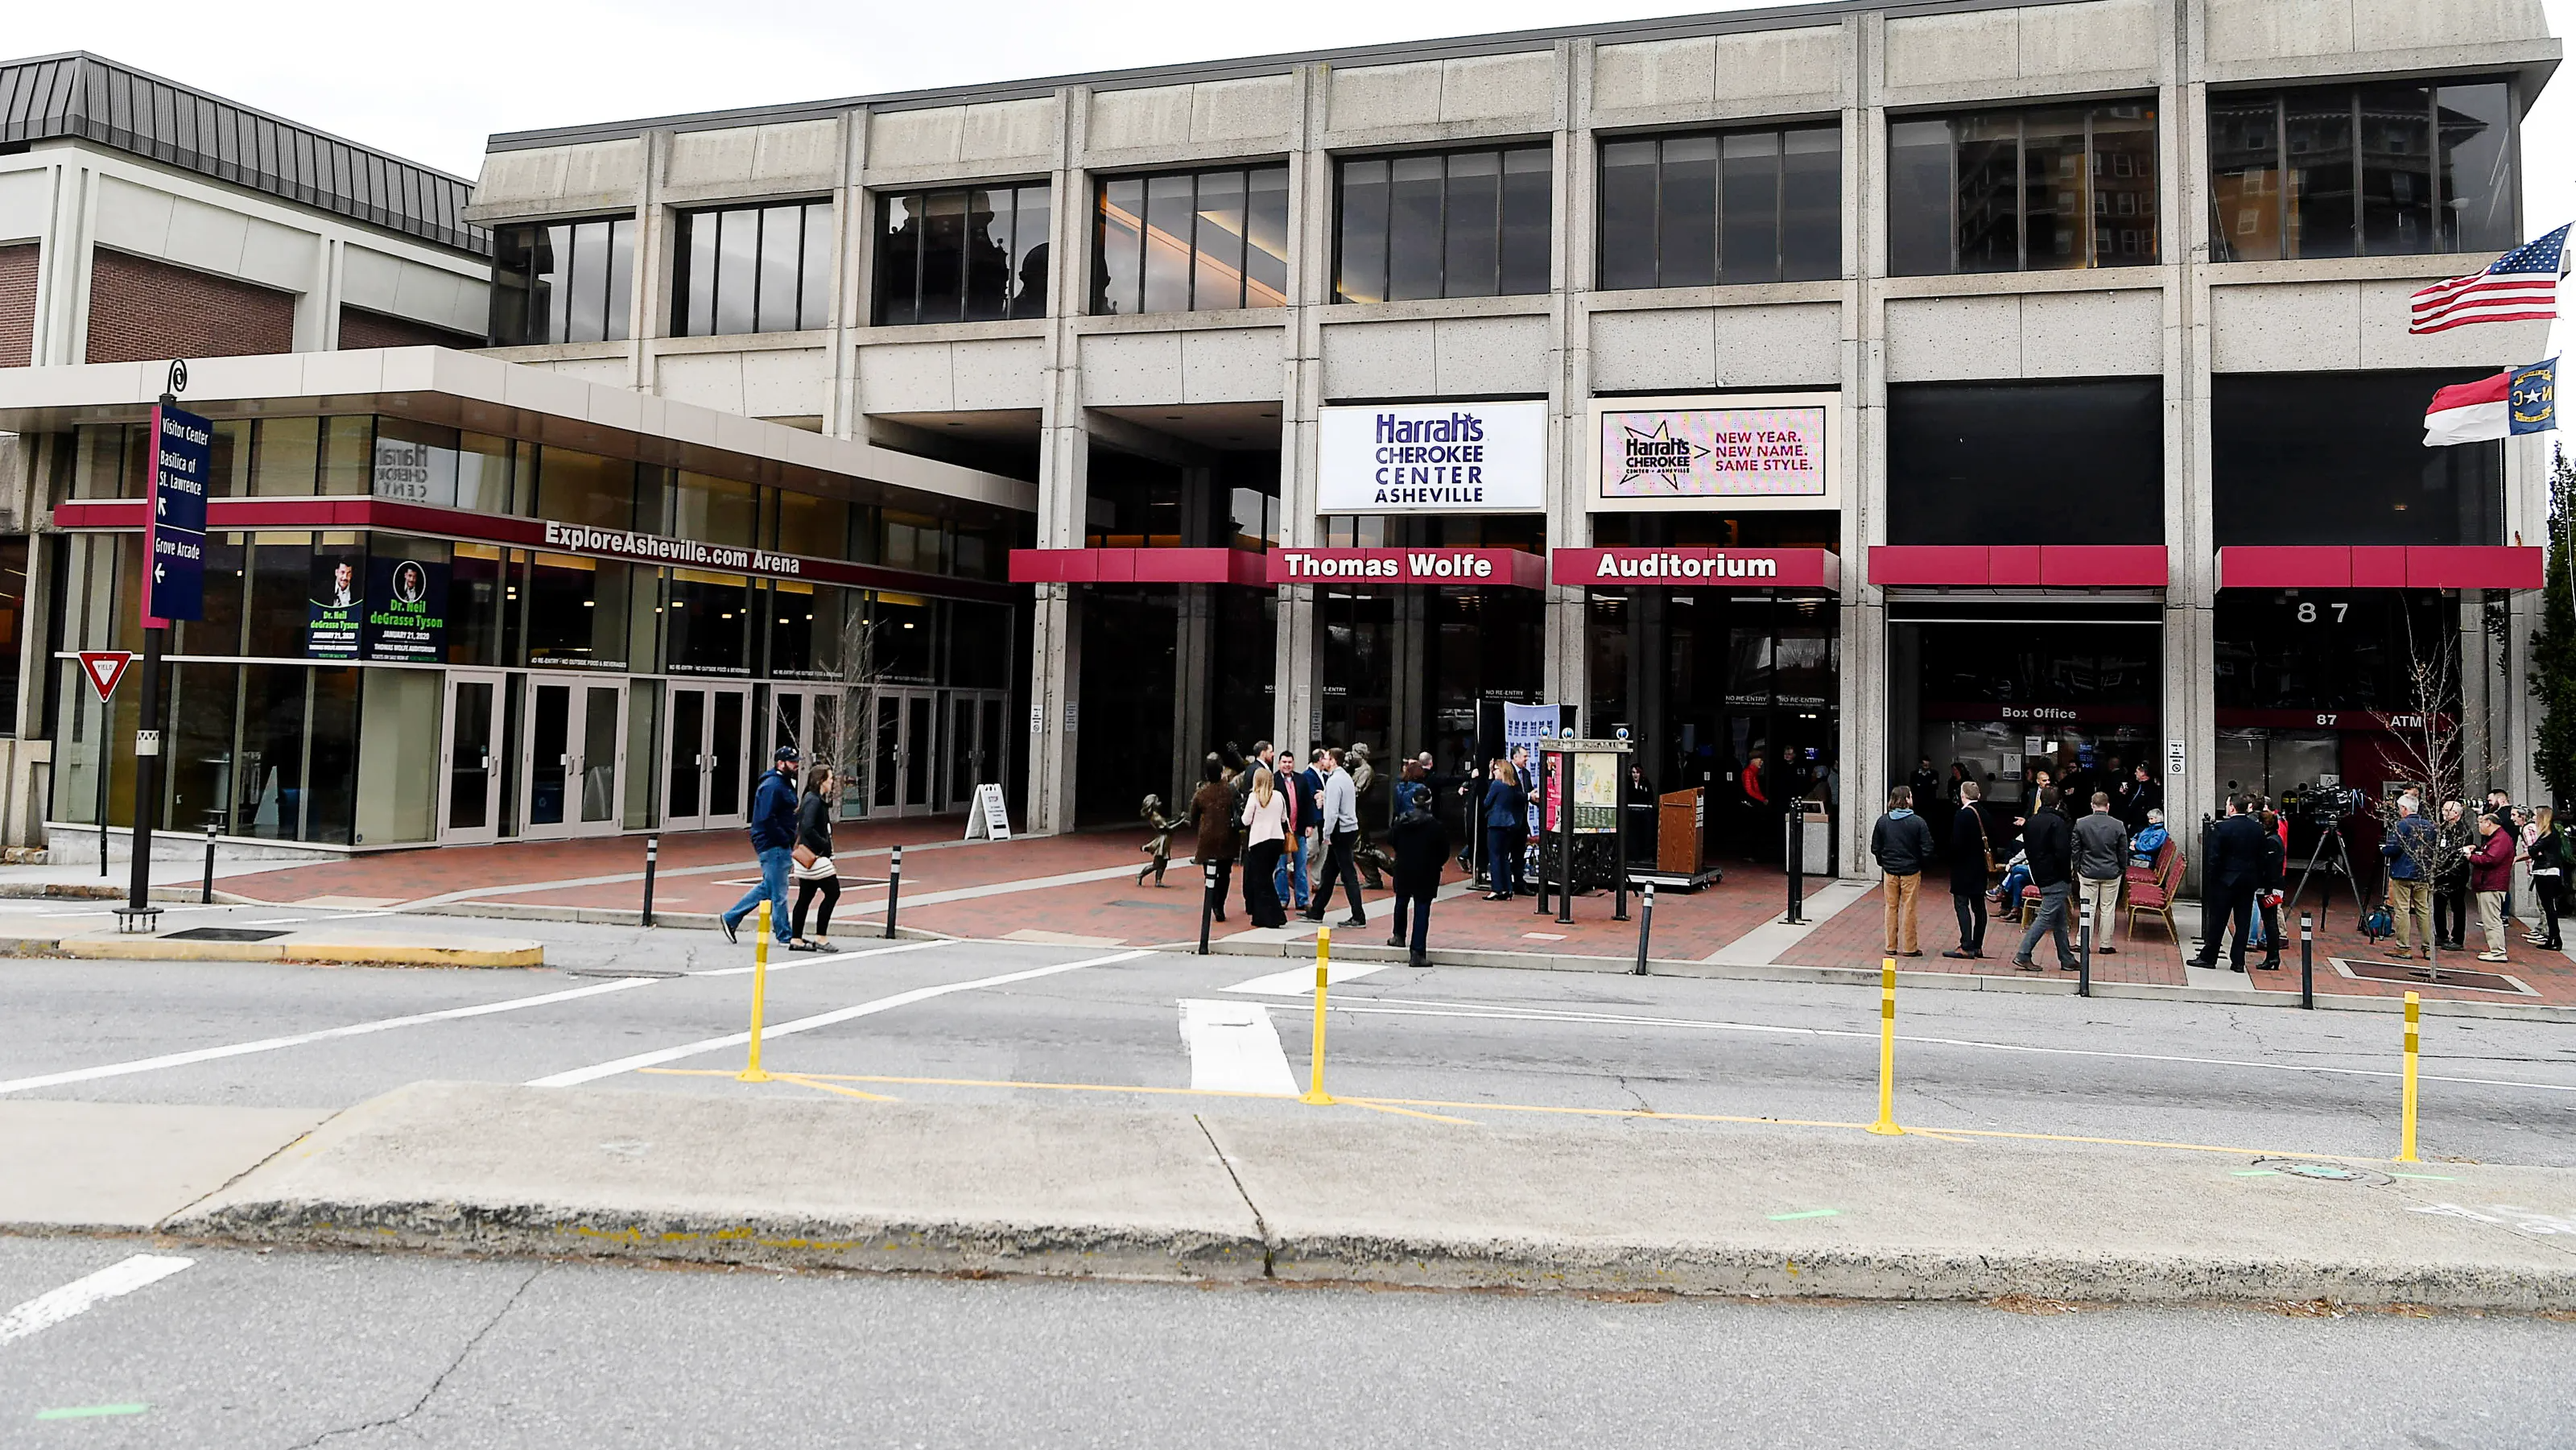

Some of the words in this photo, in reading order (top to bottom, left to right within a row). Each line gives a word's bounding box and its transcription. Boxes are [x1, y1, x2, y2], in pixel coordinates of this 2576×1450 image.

[163, 418, 184, 439] Visitor
[186, 426, 208, 446] Center
[1376, 412, 1484, 444] Harrah's
[1715, 432, 1752, 444] NEW
[1757, 431, 1801, 443] YEAR.
[1376, 445, 1484, 465] CHEROKEE
[1626, 437, 1690, 456] Harrah's
[1715, 445, 1752, 458] NEW
[1757, 444, 1808, 457] NAME.
[160, 450, 187, 471] Basilica
[188, 458, 196, 473] of
[1626, 456, 1690, 468] CHEROKEE
[1715, 460, 1758, 471] SAME
[1763, 459, 1813, 471] STYLE.
[159, 471, 168, 487] St.
[170, 473, 202, 495] Lawrence
[1376, 466, 1483, 485] CENTER
[1374, 488, 1483, 503] ASHEVILLE
[155, 537, 175, 556] Grove
[176, 541, 200, 560] Arcade
[545, 520, 748, 568] ExploreAsheville.com
[752, 550, 800, 574] Arena
[1284, 553, 1399, 577] Thomas
[1407, 553, 1492, 577] Wolfe
[1596, 553, 1777, 577] Auditorium
[324, 611, 333, 619] Dr.
[390, 599, 405, 612] Dr.
[407, 601, 426, 613] Neil
[370, 611, 415, 626] deGrasse
[415, 613, 443, 630] Tyson
[2002, 707, 2029, 717] Box
[2033, 708, 2077, 719] Office
[2317, 714, 2337, 725] 87
[2390, 716, 2422, 728] ATM
